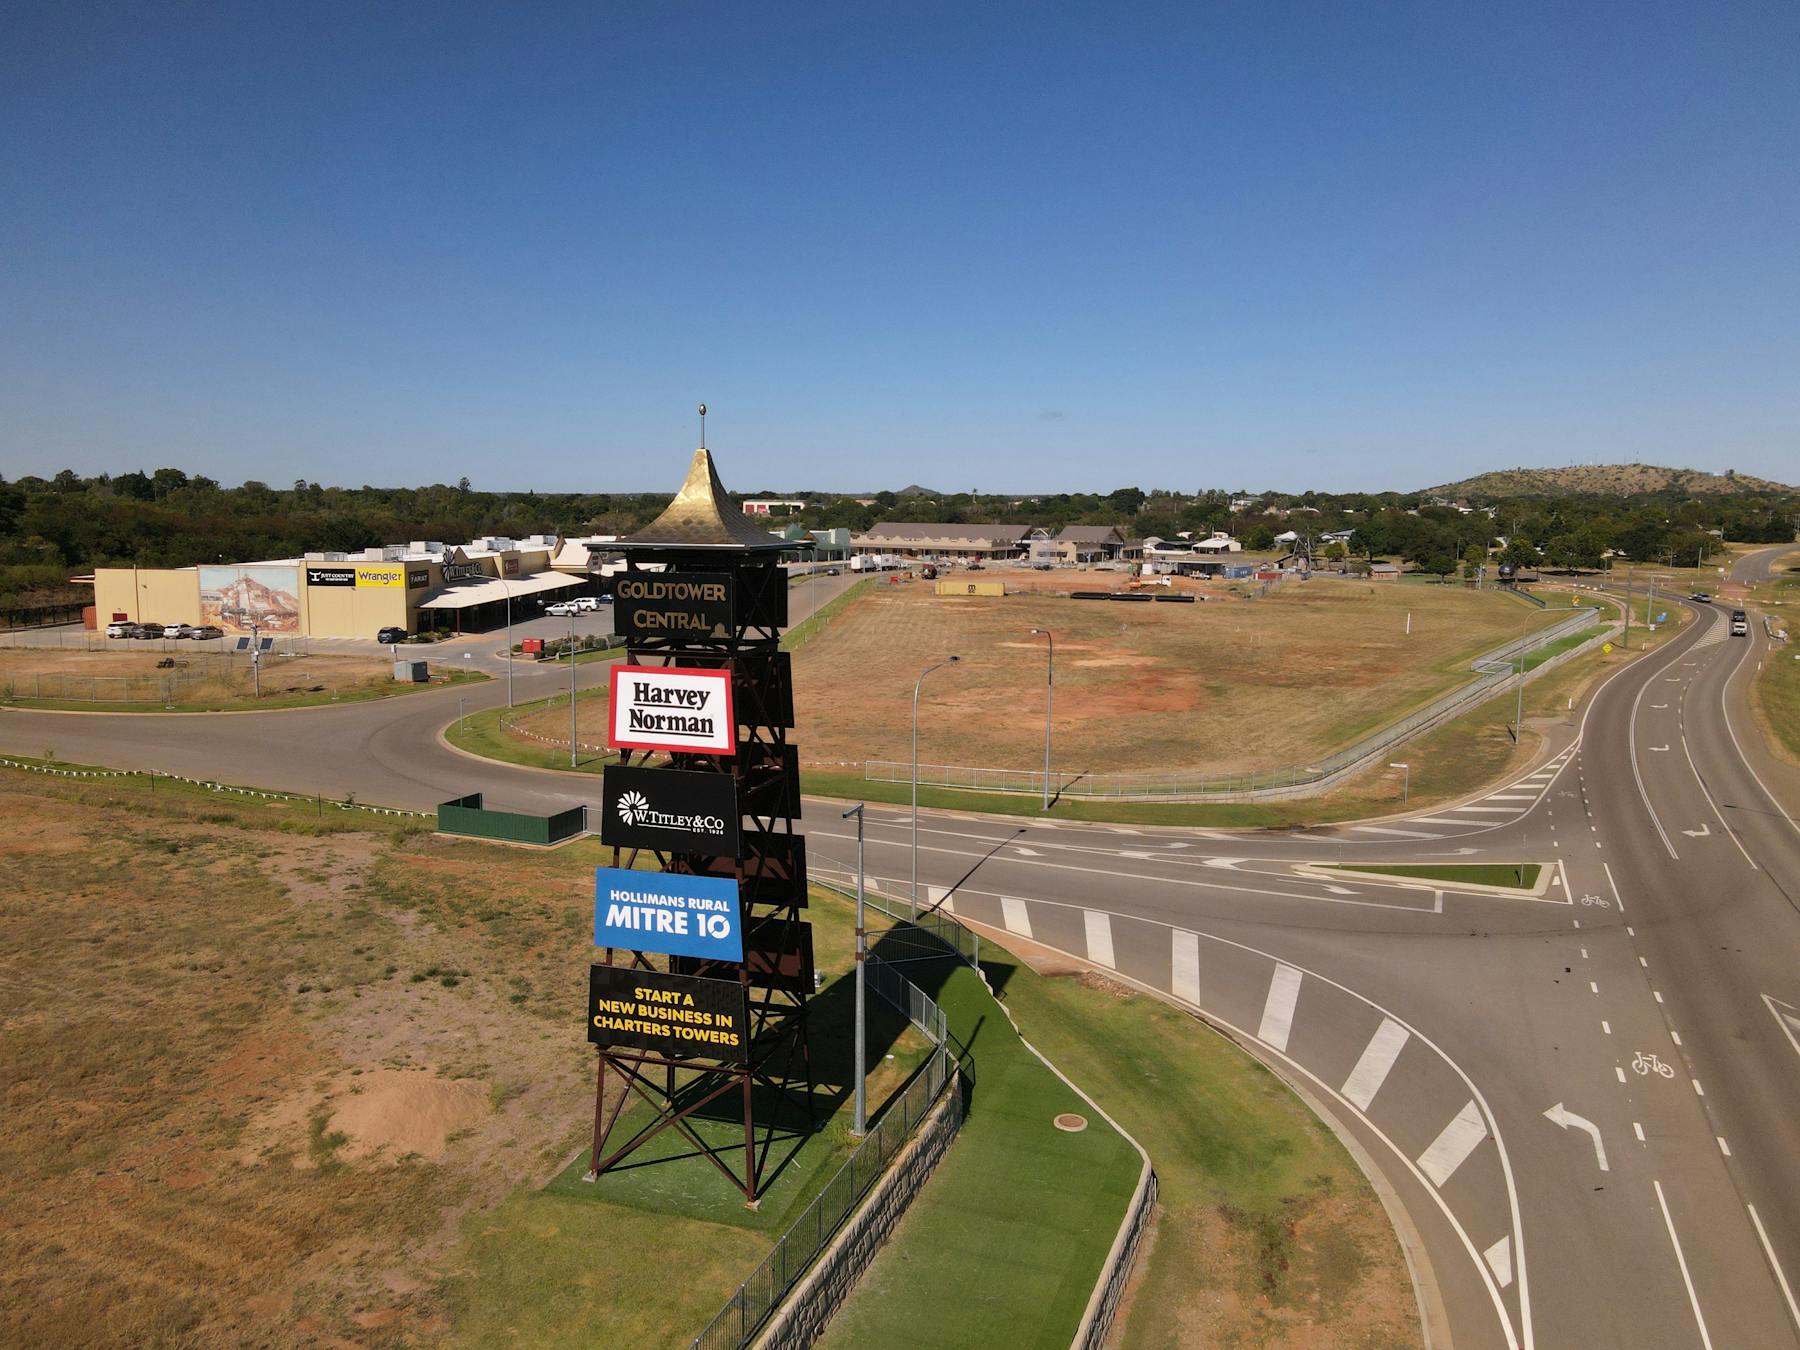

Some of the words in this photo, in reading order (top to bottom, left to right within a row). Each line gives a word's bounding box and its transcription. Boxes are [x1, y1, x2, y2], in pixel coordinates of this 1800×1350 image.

[358, 571, 401, 584] Wrangler
[617, 580, 726, 601] GOLDTOWER
[633, 609, 711, 630] CENTRAL
[633, 682, 710, 710] Harvey
[629, 708, 714, 733] Norman
[610, 890, 685, 908] HOLLIMANS
[688, 897, 730, 912] RURAL
[606, 905, 688, 935] MITRE
[697, 913, 731, 939] 10
[634, 987, 682, 1004] START
[683, 993, 694, 1006] A
[598, 1000, 637, 1015] NEW
[638, 1004, 712, 1025] BUSINESS
[715, 1013, 732, 1028] IN
[593, 1015, 671, 1037] CHARTERS
[673, 1025, 739, 1047] TOWERS
